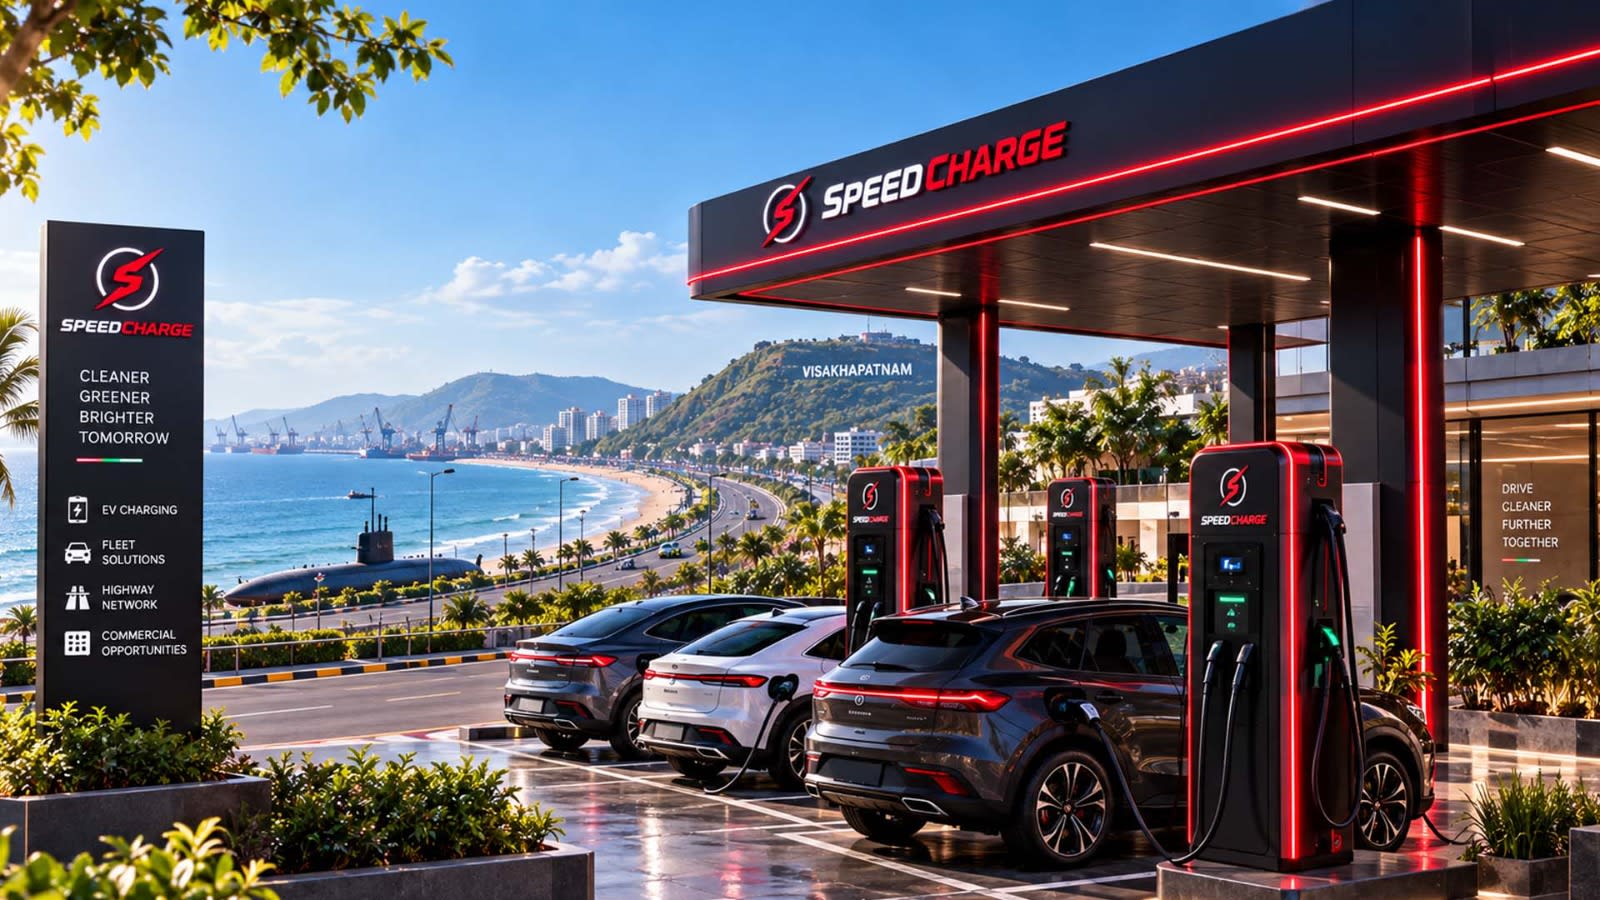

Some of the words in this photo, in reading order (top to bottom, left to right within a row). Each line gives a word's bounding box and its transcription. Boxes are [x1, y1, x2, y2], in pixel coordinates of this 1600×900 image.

[60, 318, 193, 337] SPEEDCHARGE
[802, 362, 913, 378] VISAKHAPATNAM
[79, 369, 150, 384] CLEANER
[79, 390, 150, 404] GREENER
[79, 410, 154, 424] BRIGHTER
[79, 430, 170, 445] TOMORROW
[1501, 483, 1534, 494] DRIVE
[102, 504, 117, 516] EV
[119, 504, 178, 516] CHARGING
[1501, 501, 1552, 512] CLEANER
[1502, 519, 1552, 530] FURTHER
[102, 540, 136, 550] FLEET
[1502, 536, 1559, 548] TOGETHER
[102, 554, 166, 566] SOLUTIONS
[102, 585, 155, 596] HIGHWAY
[102, 599, 158, 611] NETWORK
[101, 629, 177, 641] COMMERCIAL
[101, 644, 188, 657] OPPORTUNITIES
